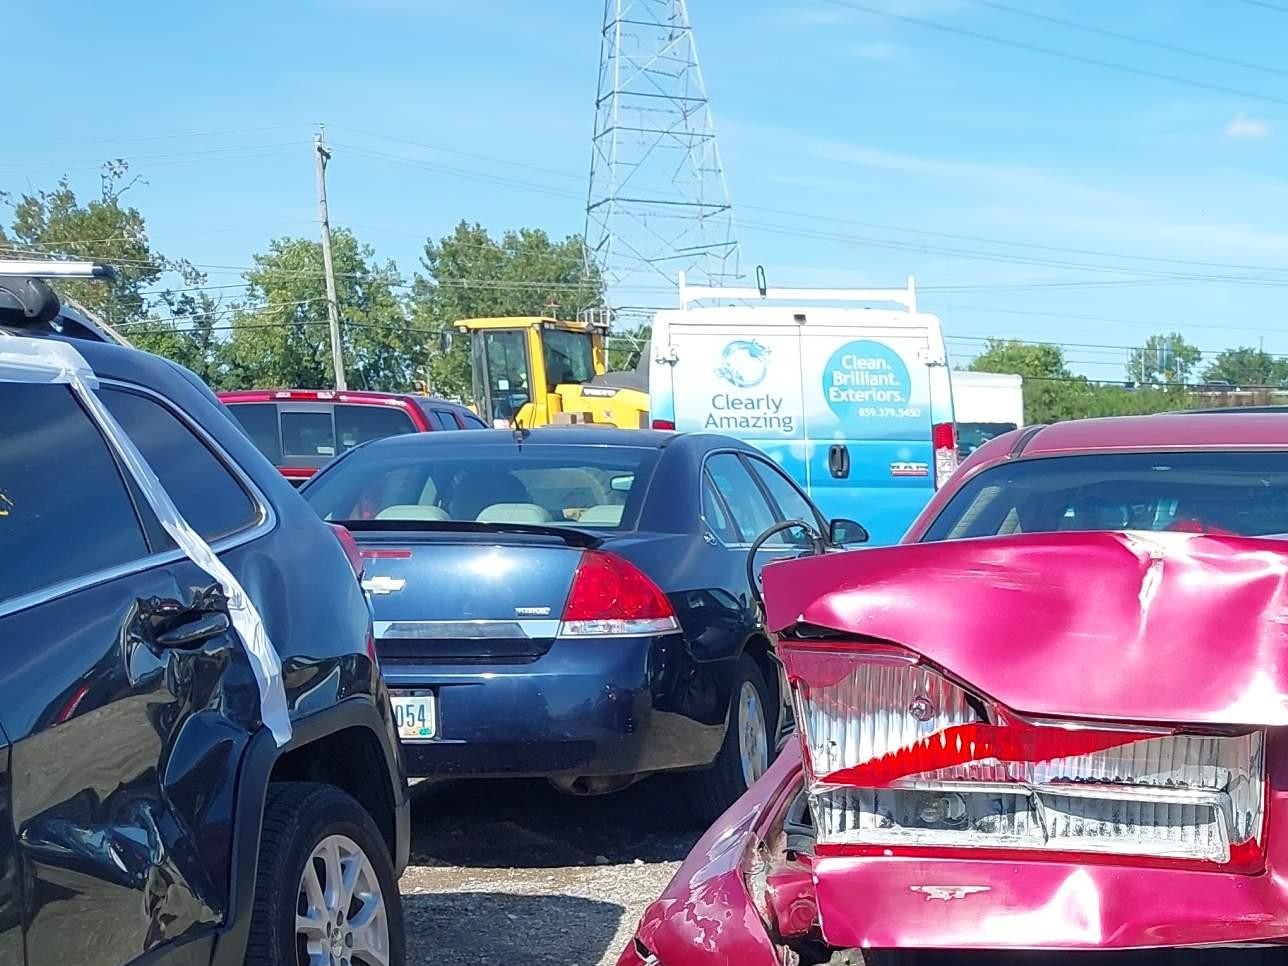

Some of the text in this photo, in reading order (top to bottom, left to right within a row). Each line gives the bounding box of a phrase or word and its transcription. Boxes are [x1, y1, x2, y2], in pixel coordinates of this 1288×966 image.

[841, 354, 892, 370] Clean.
[832, 370, 900, 386] Brilliant.
[829, 386, 906, 402] Exteriors.
[711, 393, 783, 414] Clearly
[704, 412, 794, 432] Amazing
